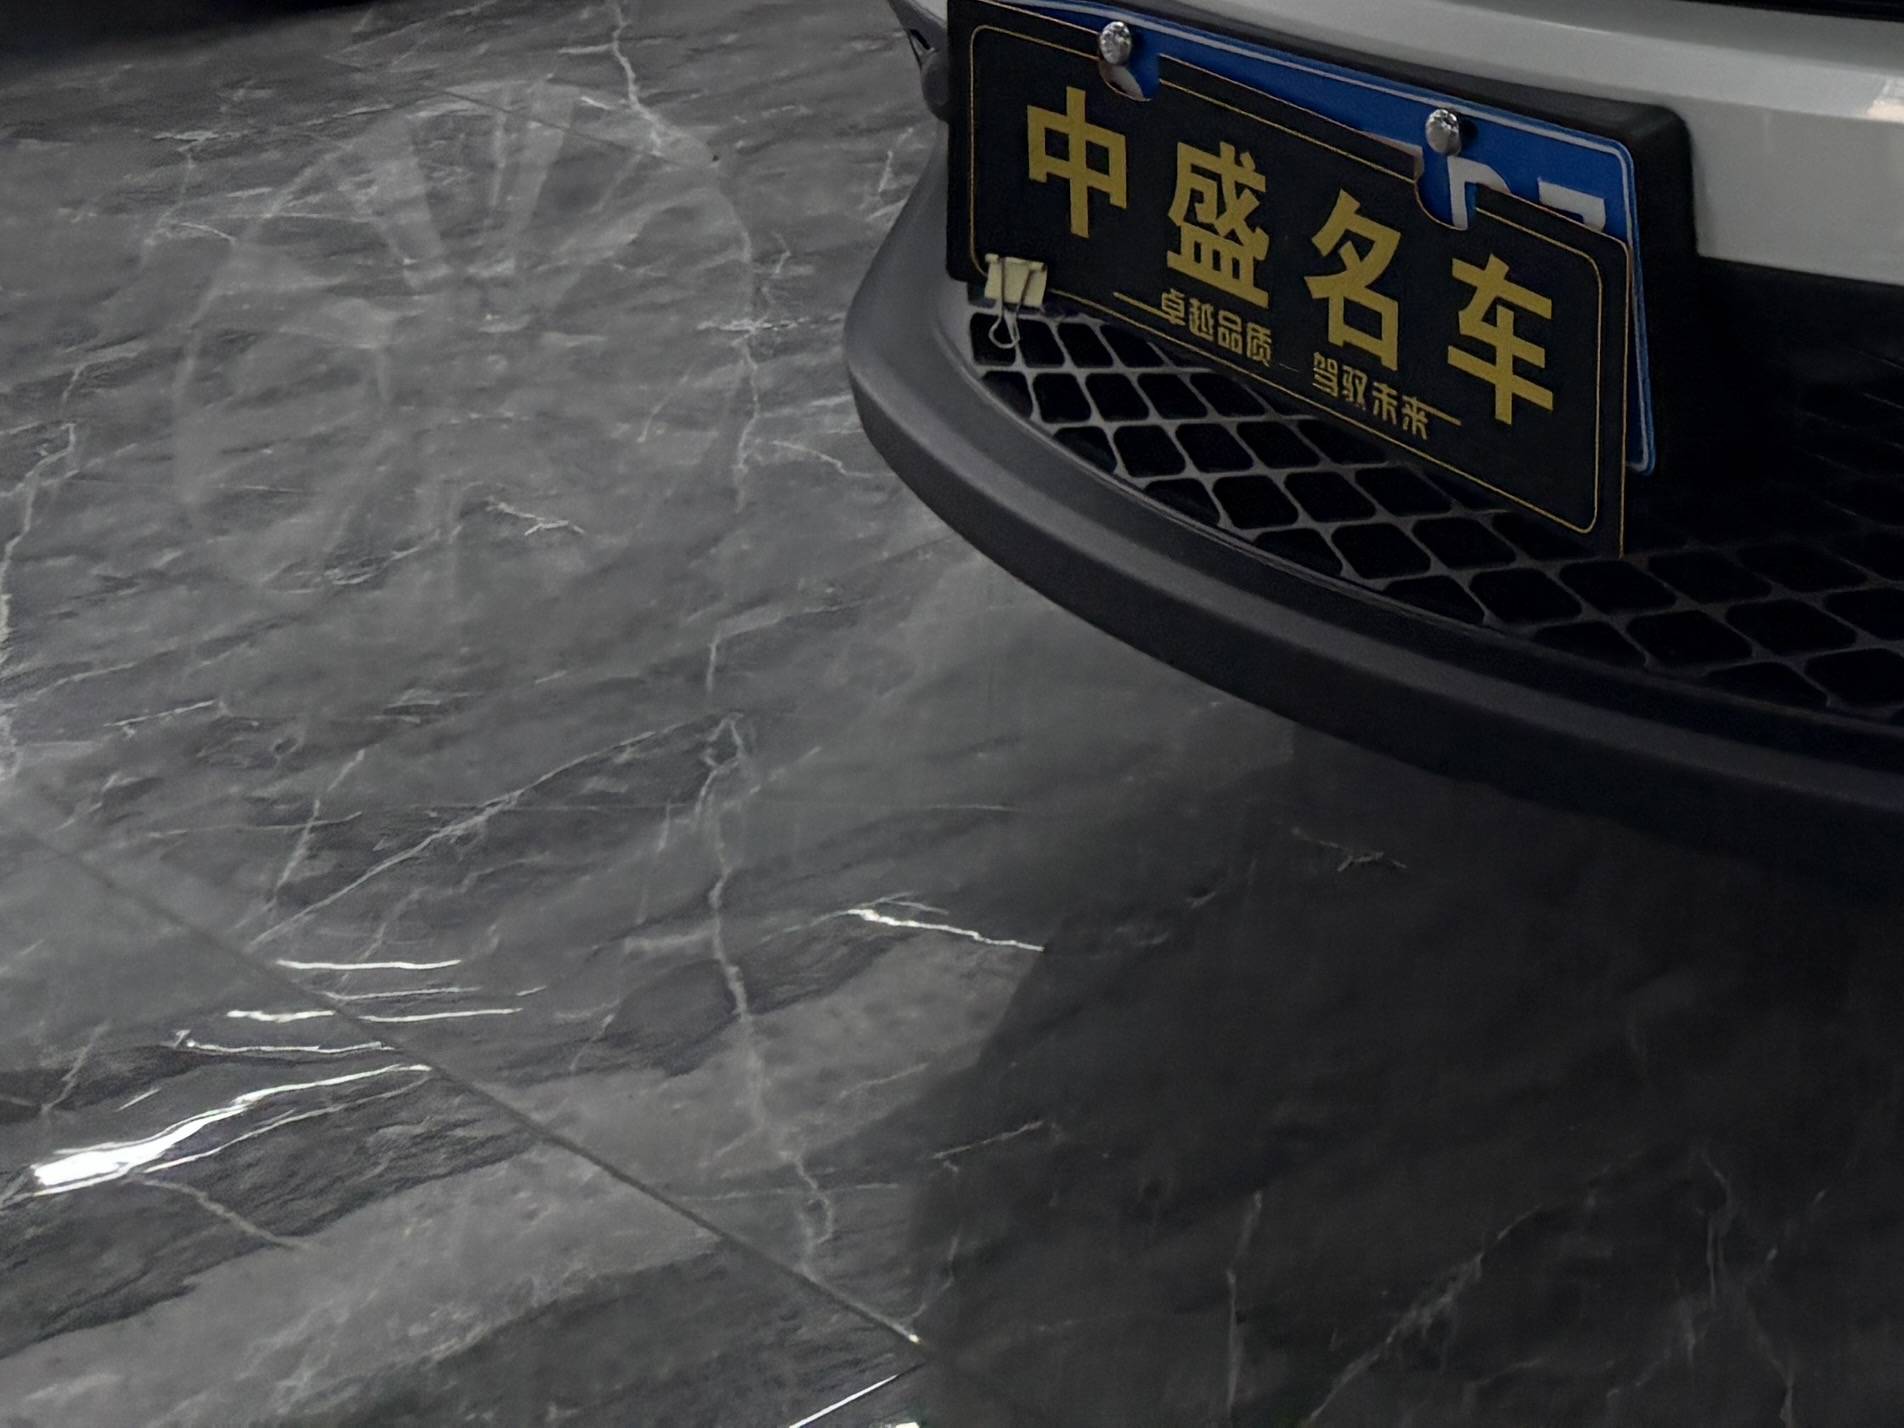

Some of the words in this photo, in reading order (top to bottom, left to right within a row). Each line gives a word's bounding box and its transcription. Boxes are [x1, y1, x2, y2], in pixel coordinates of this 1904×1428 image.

[1026, 87, 1553, 424] 中盛名车
[1160, 288, 1272, 368] 卓越品质
[1312, 351, 1429, 440] 驾驭未来
